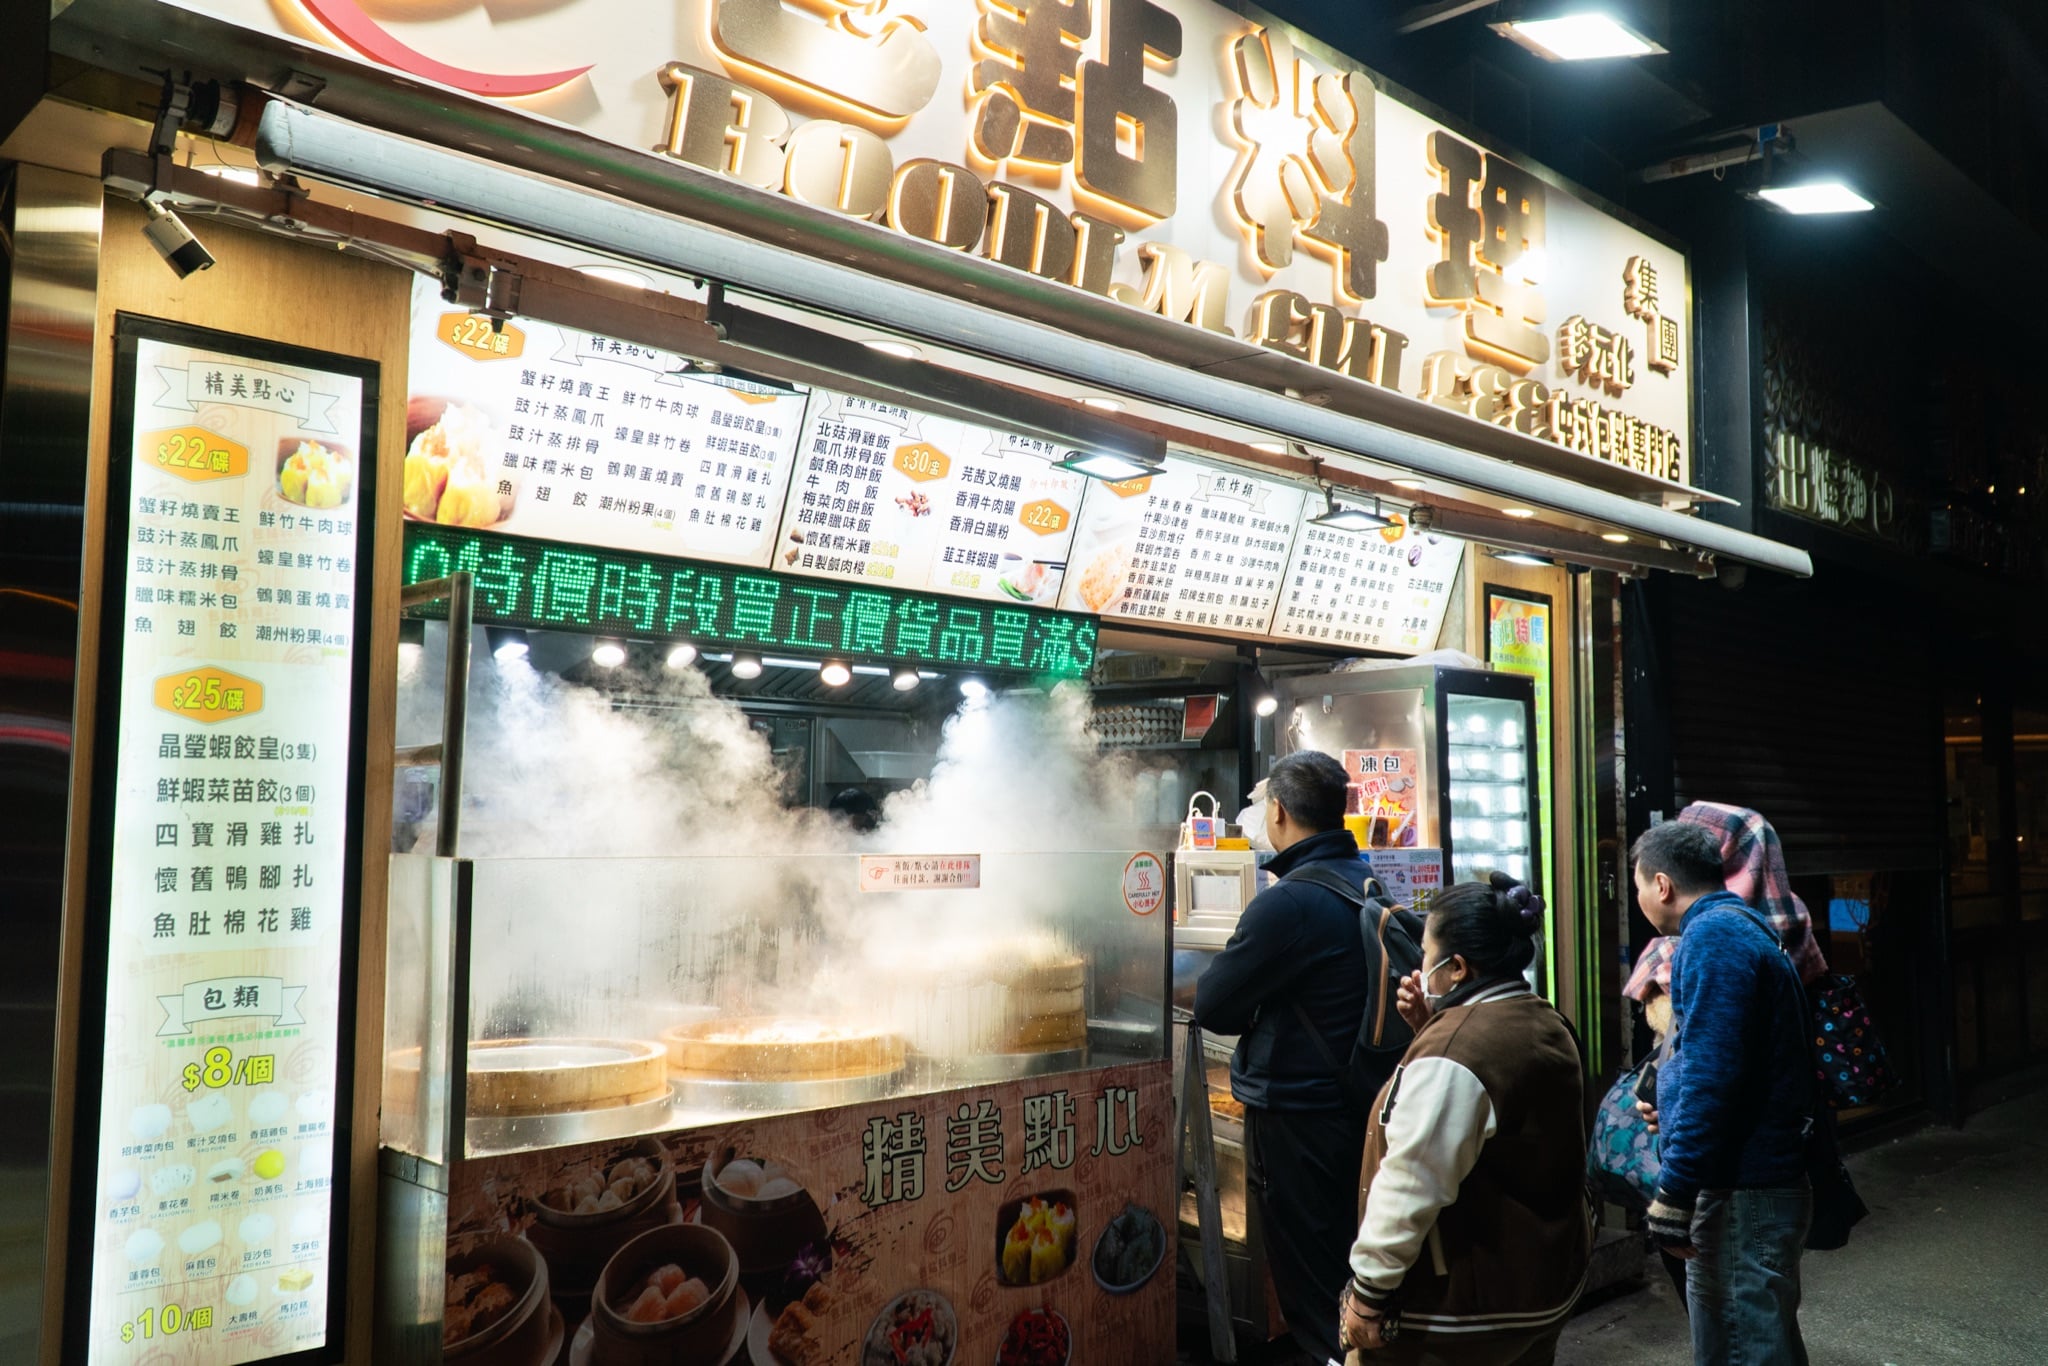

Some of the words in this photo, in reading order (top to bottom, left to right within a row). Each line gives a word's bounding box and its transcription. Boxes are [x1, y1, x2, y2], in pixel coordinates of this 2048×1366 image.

[1623, 255, 1679, 371] 集團
[203, 370, 296, 404] 精美點心
[520, 368, 611, 402] 蟹籽燒賣王
[622, 390, 700, 419] 鮮竹牛肉球
[514, 396, 607, 428] 豉汁蒸鳳爪
[508, 424, 600, 455] 豉汁蒸排骨
[817, 421, 892, 451] 北菇滑雞飯
[156, 433, 231, 474] $22/碟
[502, 451, 595, 482] 臘味糯米包
[813, 438, 888, 468] 鳳爪排骨飯
[808, 456, 883, 484] 鹹魚肉餅飯
[961, 465, 1023, 493] 芫茜叉燒腸
[956, 490, 1017, 516] 香滑牛肉腸
[1214, 476, 1254, 499] 煎炸類
[138, 496, 241, 524] 蟹籽燒賣王
[258, 511, 353, 536] 鮮竹牛肉球
[801, 490, 876, 518] 梅菜肉餅飯
[797, 507, 872, 534] 招牌臘味飯
[949, 514, 1010, 541] 香滑白腸粉
[137, 526, 240, 552] 豉汁蒸鳳爪
[256, 549, 352, 573] 蠔皇鮮竹卷
[136, 556, 239, 582] 豉汁蒸排骨
[255, 586, 351, 610] 鵪鶉蛋燒賣
[133, 616, 237, 640] 魚翅餃
[134, 586, 238, 610] 臘味糯米包
[254, 625, 350, 647] 潮州粉果(4個)
[172, 676, 245, 711] $25/碟
[1360, 756, 1401, 773] 凍包
[156, 777, 316, 803] 鮮蝦菜苗餃(3個)
[155, 820, 315, 847] 四寶滑雞扎
[154, 863, 314, 894] 懷舊鴨腳扎
[153, 906, 313, 938] 魚肚棉花雞
[202, 984, 260, 1011] 包類
[182, 1046, 275, 1092] $8/個
[121, 1140, 175, 1157] 招牌菜肉包
[186, 1132, 238, 1149] 蜜汁叉燒包
[249, 1126, 289, 1140] 香菇雞包
[860, 1086, 1144, 1208] 精美點心
[109, 1204, 142, 1219] 香芋包
[253, 1183, 285, 1197] 奶黃包
[242, 1247, 273, 1263] 豆沙包
[290, 1240, 320, 1254] 芝麻包
[119, 1302, 214, 1344] $10/個
